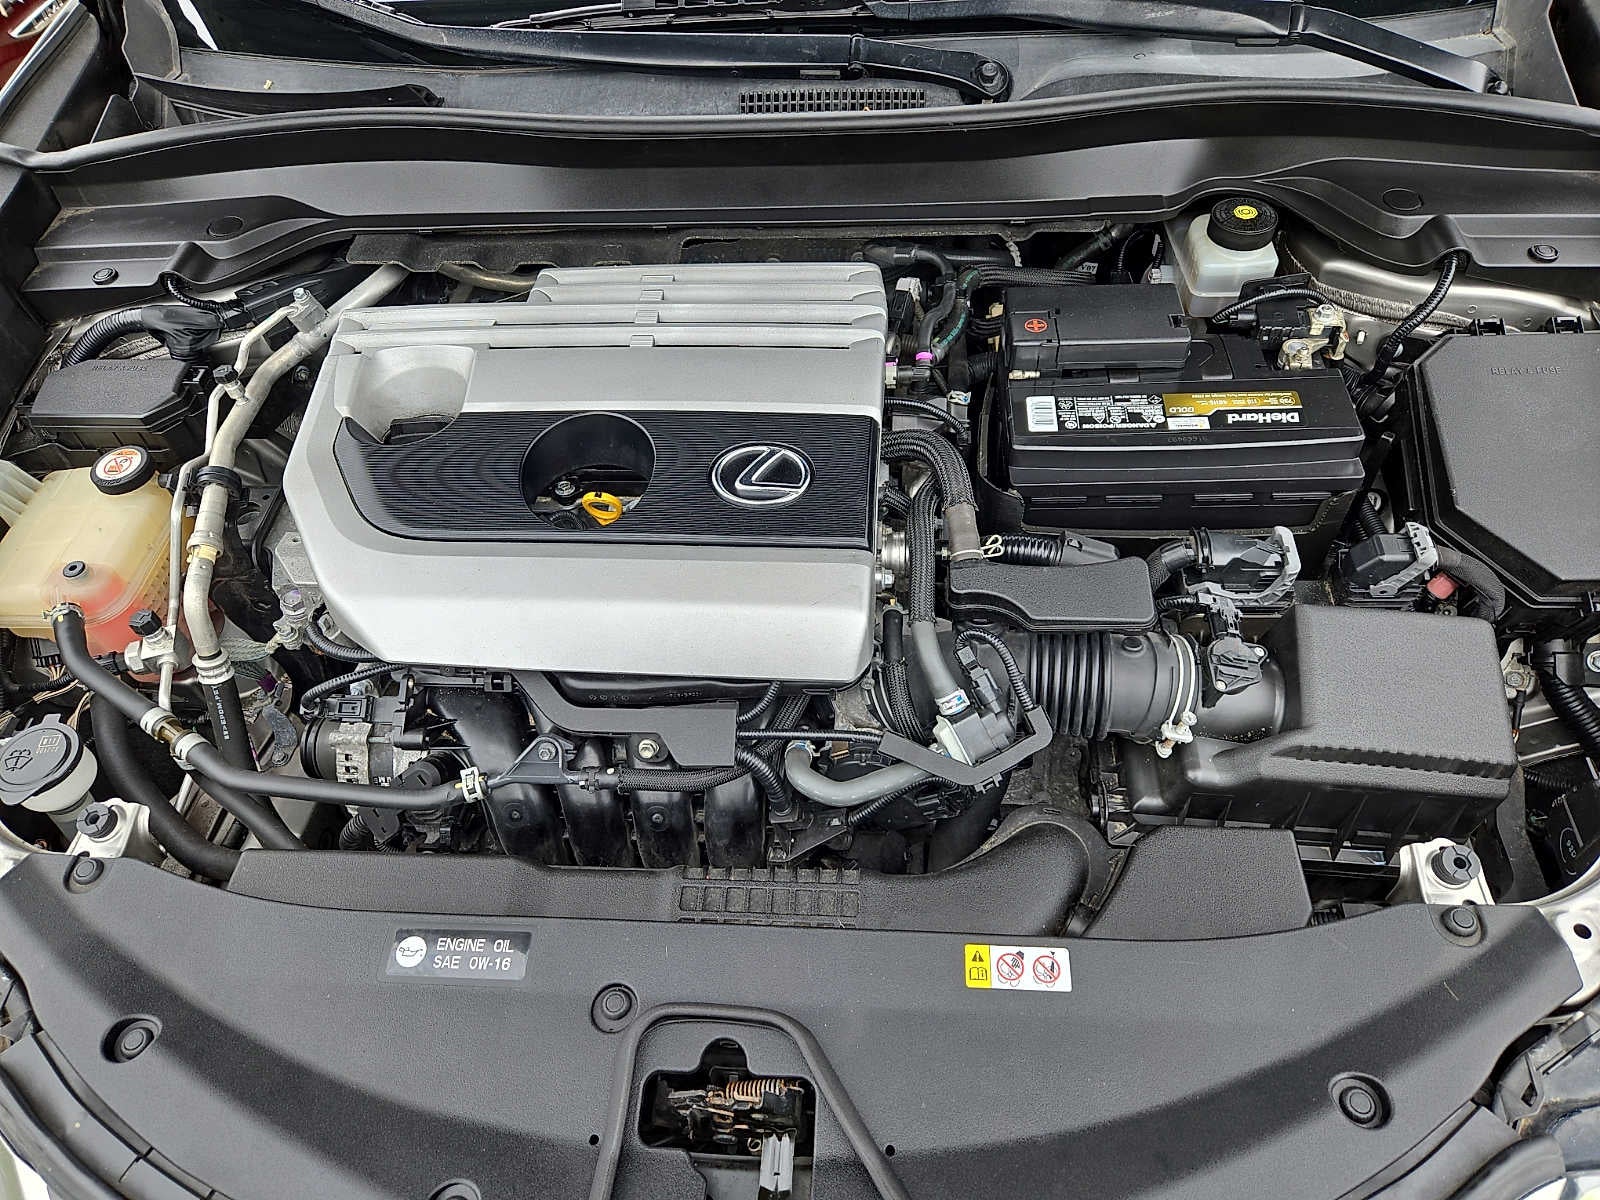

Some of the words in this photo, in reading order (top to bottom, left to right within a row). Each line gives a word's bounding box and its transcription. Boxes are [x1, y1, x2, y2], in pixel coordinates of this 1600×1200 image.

[1490, 367, 1522, 376] RELAY
[1536, 366, 1561, 375] FUSE
[1227, 412, 1300, 423] DieHard
[437, 938, 485, 953] ENGINE
[493, 939, 514, 953] OIL
[433, 955, 460, 969] SAE
[469, 957, 511, 970] 0W-16
